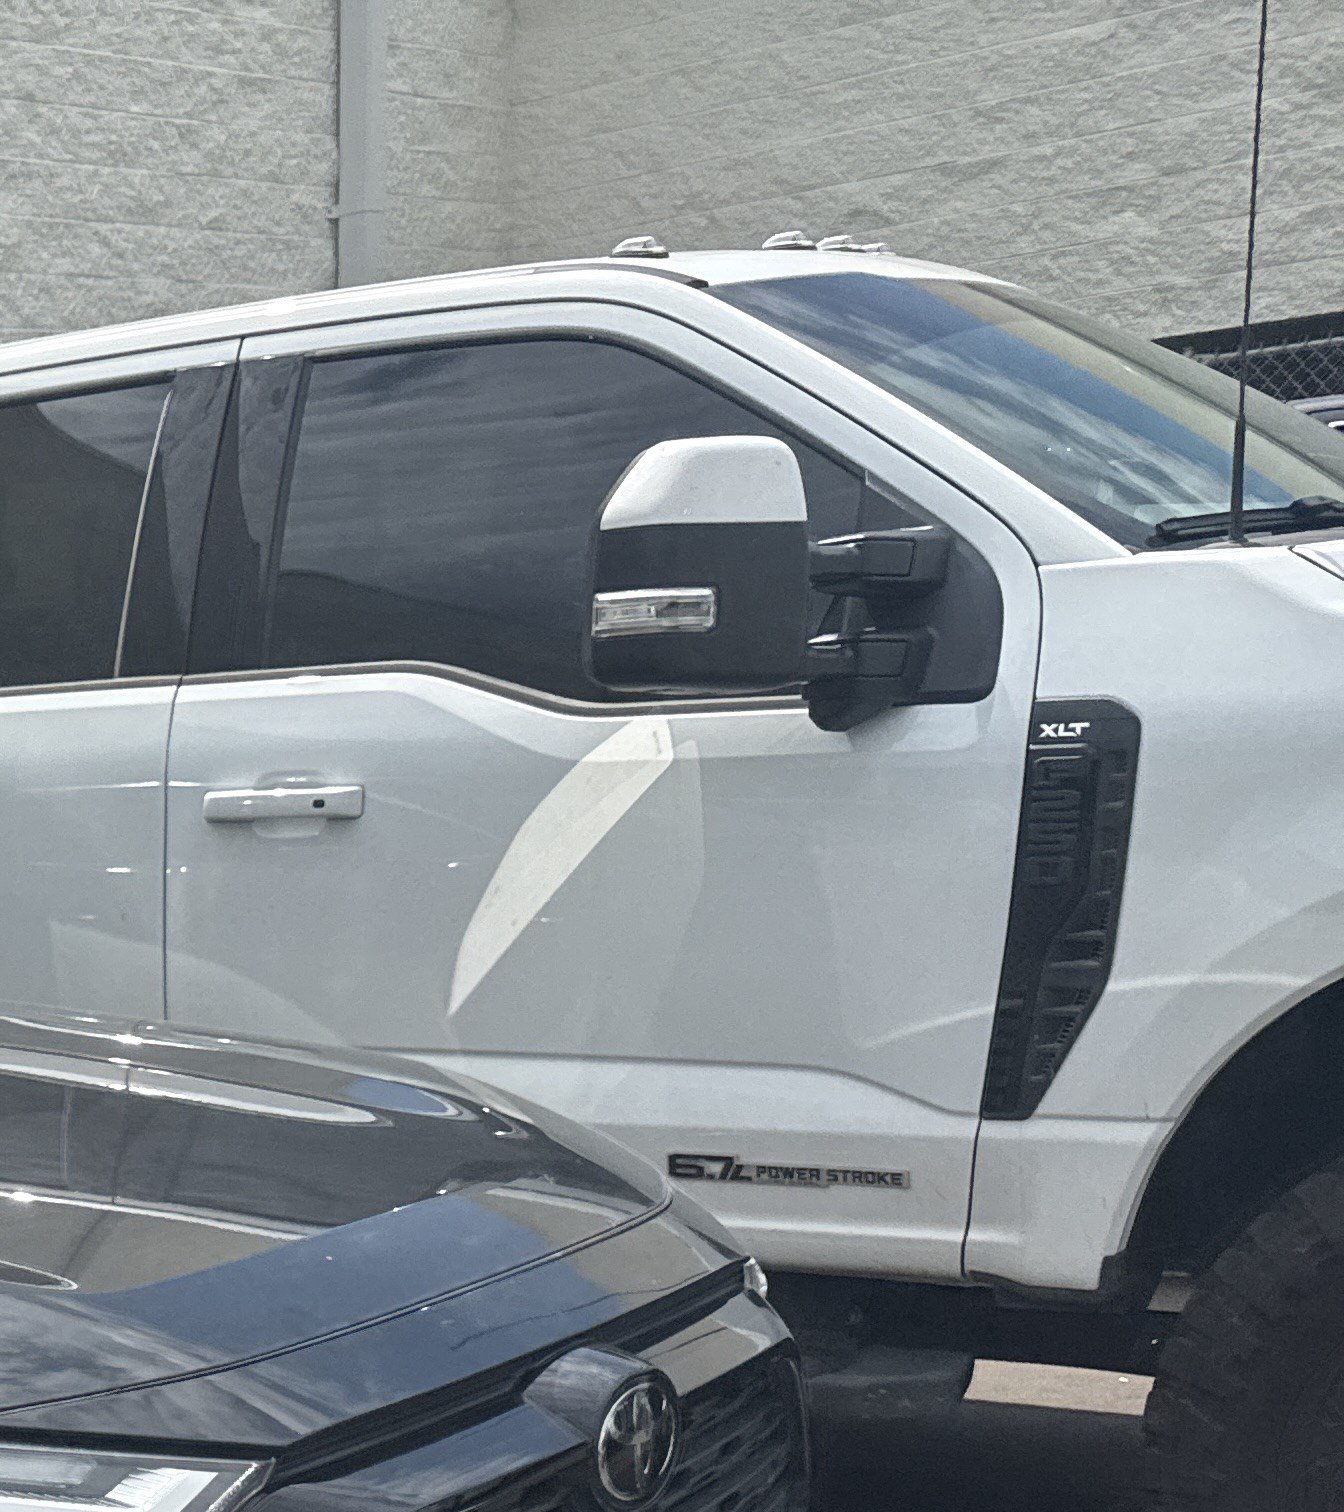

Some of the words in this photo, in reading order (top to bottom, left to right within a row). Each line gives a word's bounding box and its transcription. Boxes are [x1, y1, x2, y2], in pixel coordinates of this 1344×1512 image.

[1039, 722, 1090, 738] XLT
[756, 1165, 820, 1183] POWER
[826, 1168, 904, 1187] STROKE
